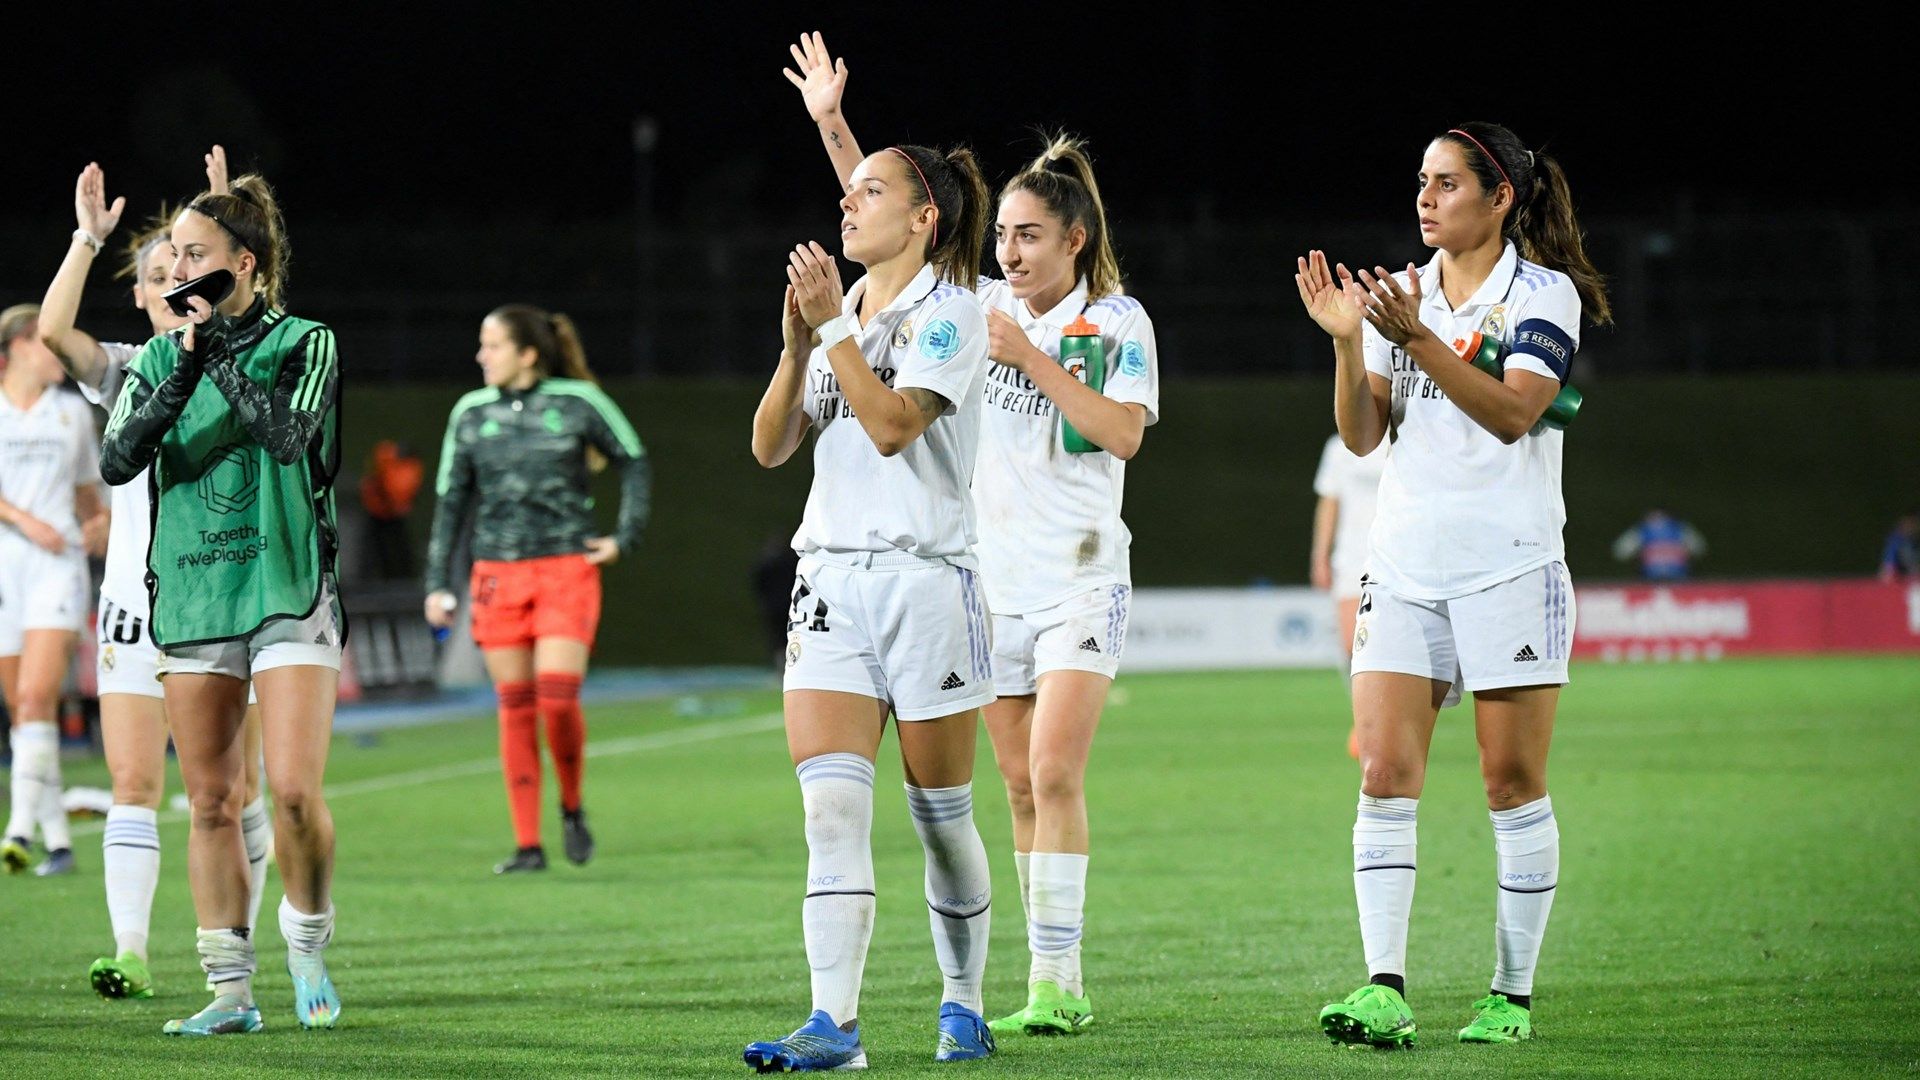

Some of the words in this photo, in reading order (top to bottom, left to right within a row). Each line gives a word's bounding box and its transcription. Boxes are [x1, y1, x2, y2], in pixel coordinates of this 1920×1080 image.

[1531, 334, 1566, 359] RESPECT
[1401, 376, 1420, 398] FLY
[982, 382, 1003, 405] FLY
[1002, 391, 1052, 417] BETTER
[817, 397, 839, 420] FLY
[198, 523, 260, 546] Togeth
[1513, 654, 1539, 662] adidas
[940, 680, 966, 691] adidas
[1355, 849, 1395, 861] MCF
[808, 875, 847, 887] MCF
[1505, 871, 1552, 883] RMCF
